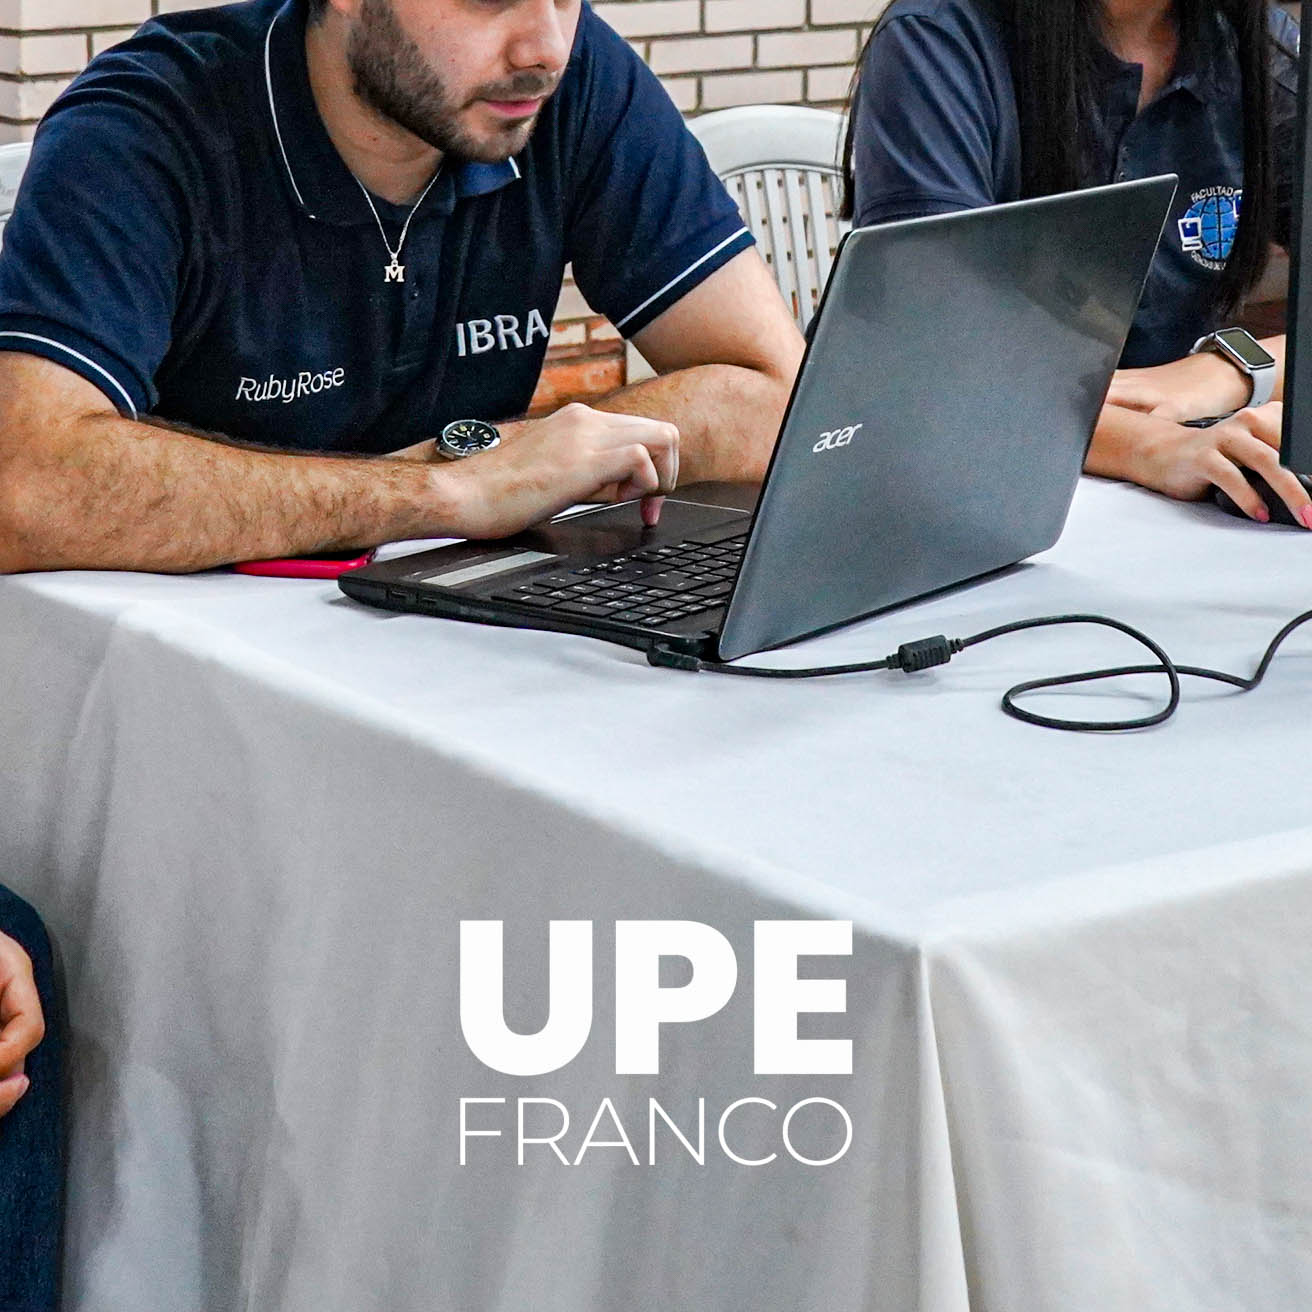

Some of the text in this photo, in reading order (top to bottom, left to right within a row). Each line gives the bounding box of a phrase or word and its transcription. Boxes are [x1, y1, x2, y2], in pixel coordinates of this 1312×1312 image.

[1190, 185, 1234, 203] FACULTAD
[384, 264, 405, 283] M
[455, 308, 551, 357] IBRA
[234, 366, 345, 403] RubyRose
[812, 423, 864, 454] acer
